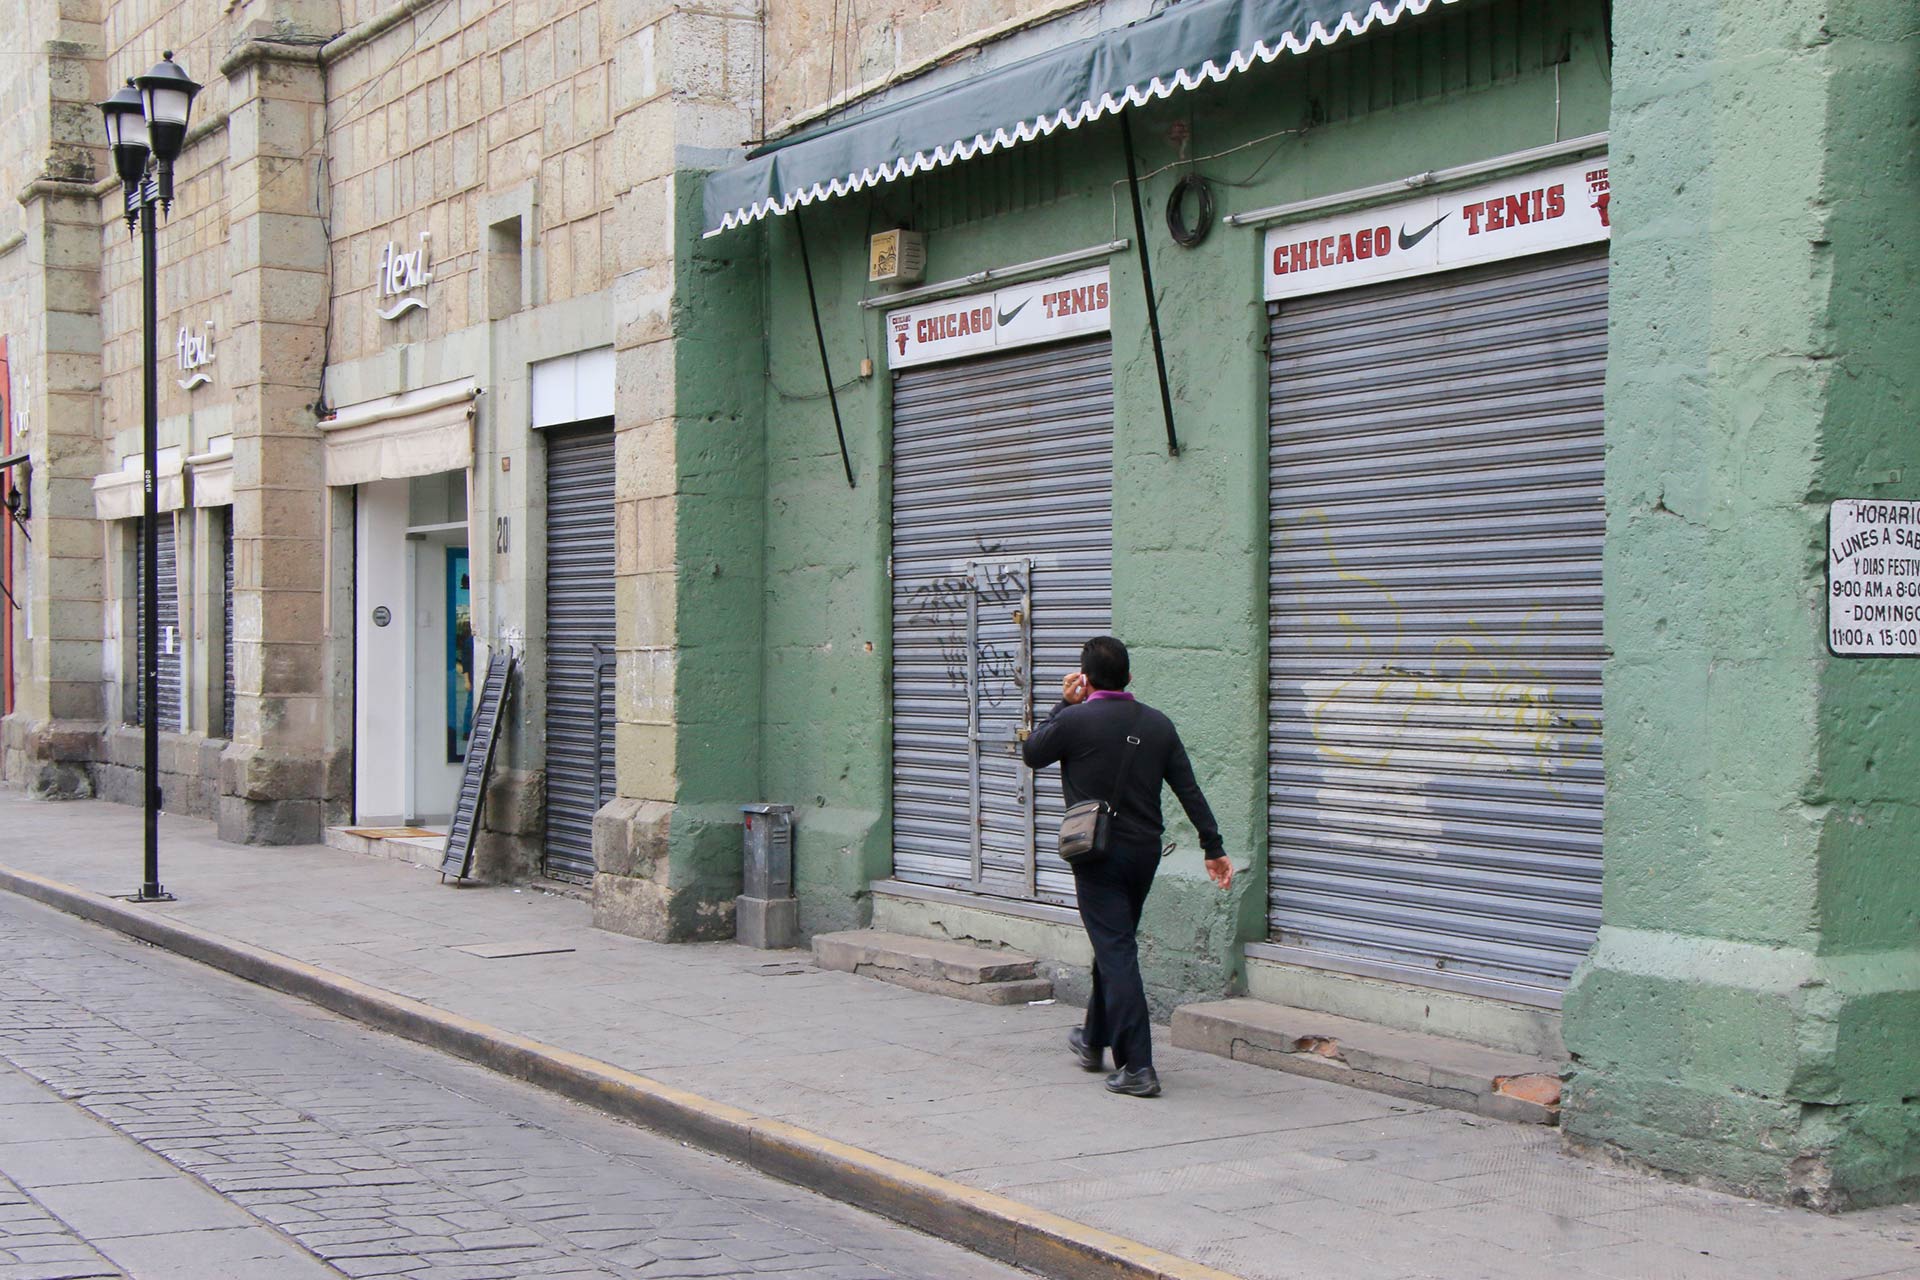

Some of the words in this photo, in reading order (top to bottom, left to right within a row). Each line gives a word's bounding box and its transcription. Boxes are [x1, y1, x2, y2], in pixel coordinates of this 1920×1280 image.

[1273, 225, 1391, 275] CHICAGO
[1463, 184, 1565, 236] TENIS
[917, 306, 993, 344] CHICAGO
[1042, 282, 1109, 319] TENIS
[1832, 529, 1879, 565] LUNES
[1882, 527, 1891, 545] A
[1853, 557, 1860, 576] Y
[1863, 557, 1885, 576] DIAS
[1832, 580, 1862, 597] 9:00
[1865, 581, 1883, 597] AM
[1885, 585, 1893, 597] A
[1896, 581, 1920, 598] 8:0
[1832, 628, 1863, 646] 11:00
[1866, 633, 1874, 646] A
[1878, 629, 1917, 646] 15:00
